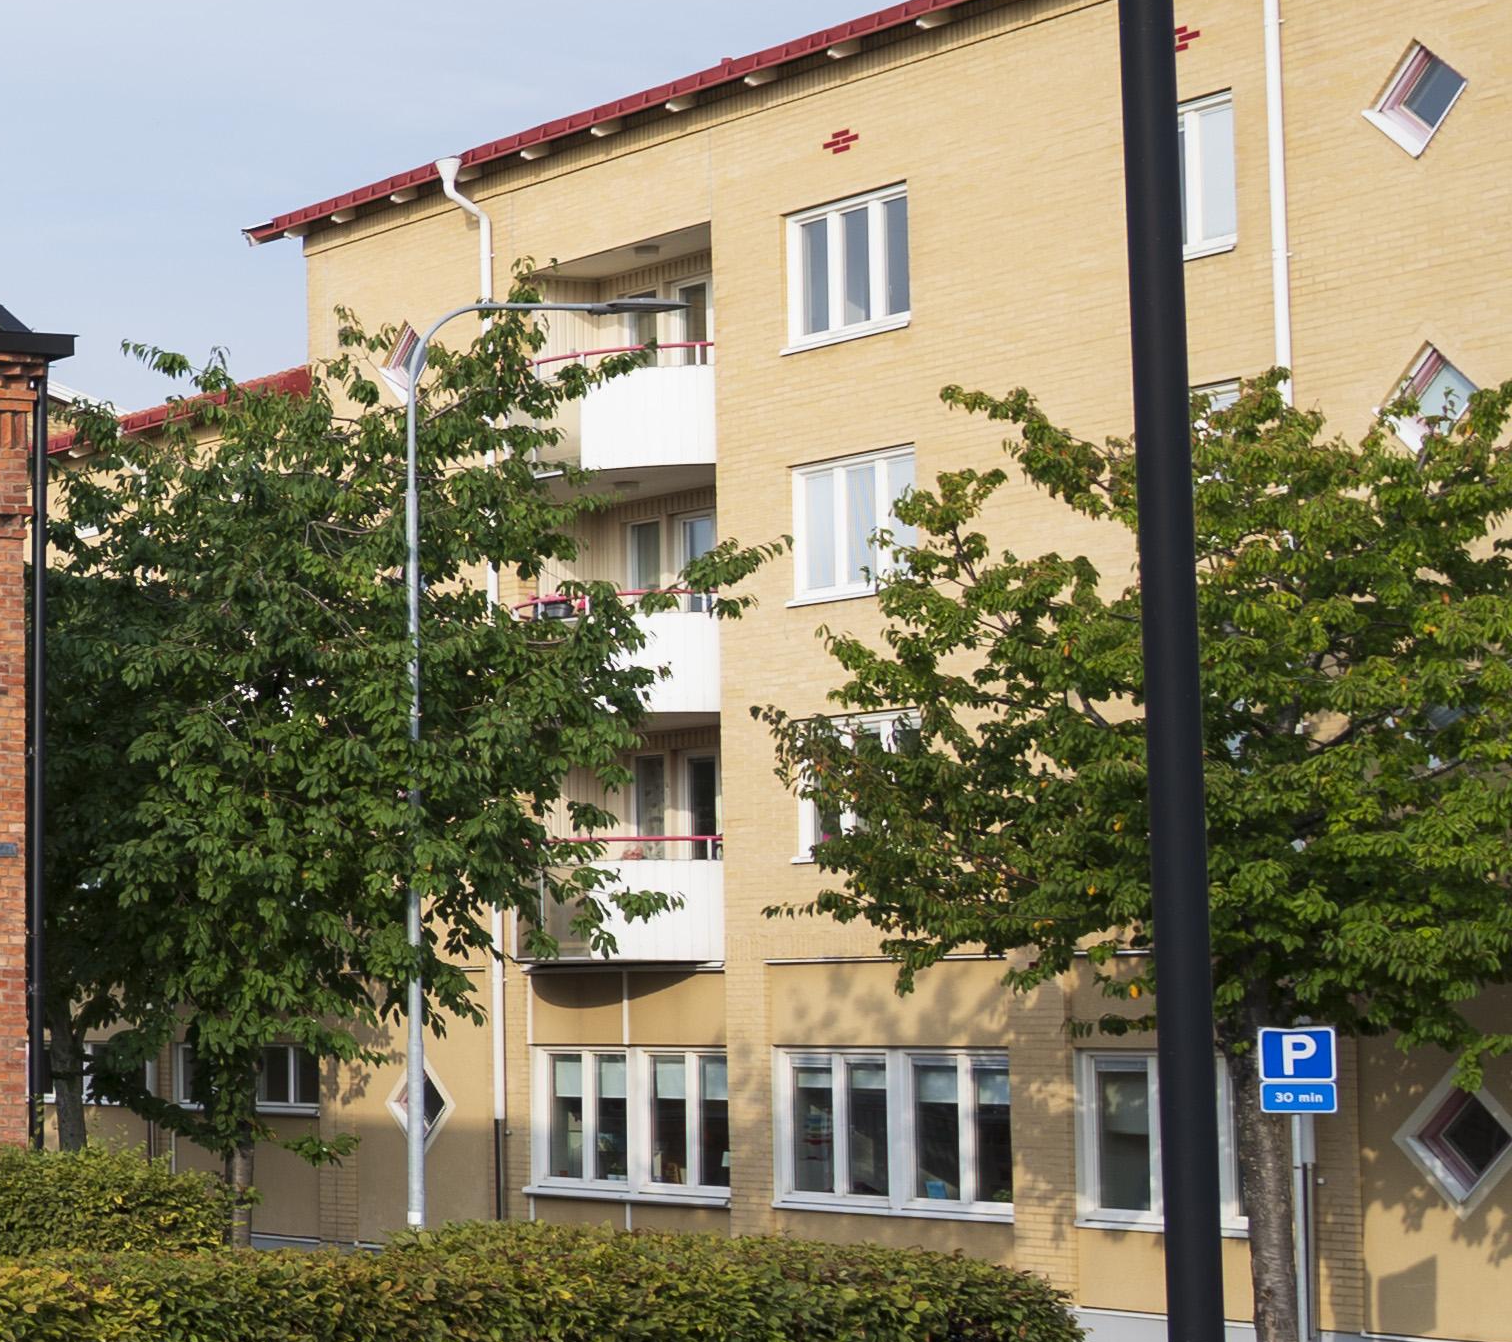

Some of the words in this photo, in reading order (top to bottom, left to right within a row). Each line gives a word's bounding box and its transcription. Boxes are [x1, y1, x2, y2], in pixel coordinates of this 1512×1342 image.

[1281, 1034, 1317, 1075] P
[1274, 1092, 1294, 1103] 30
[1298, 1092, 1324, 1103] min
